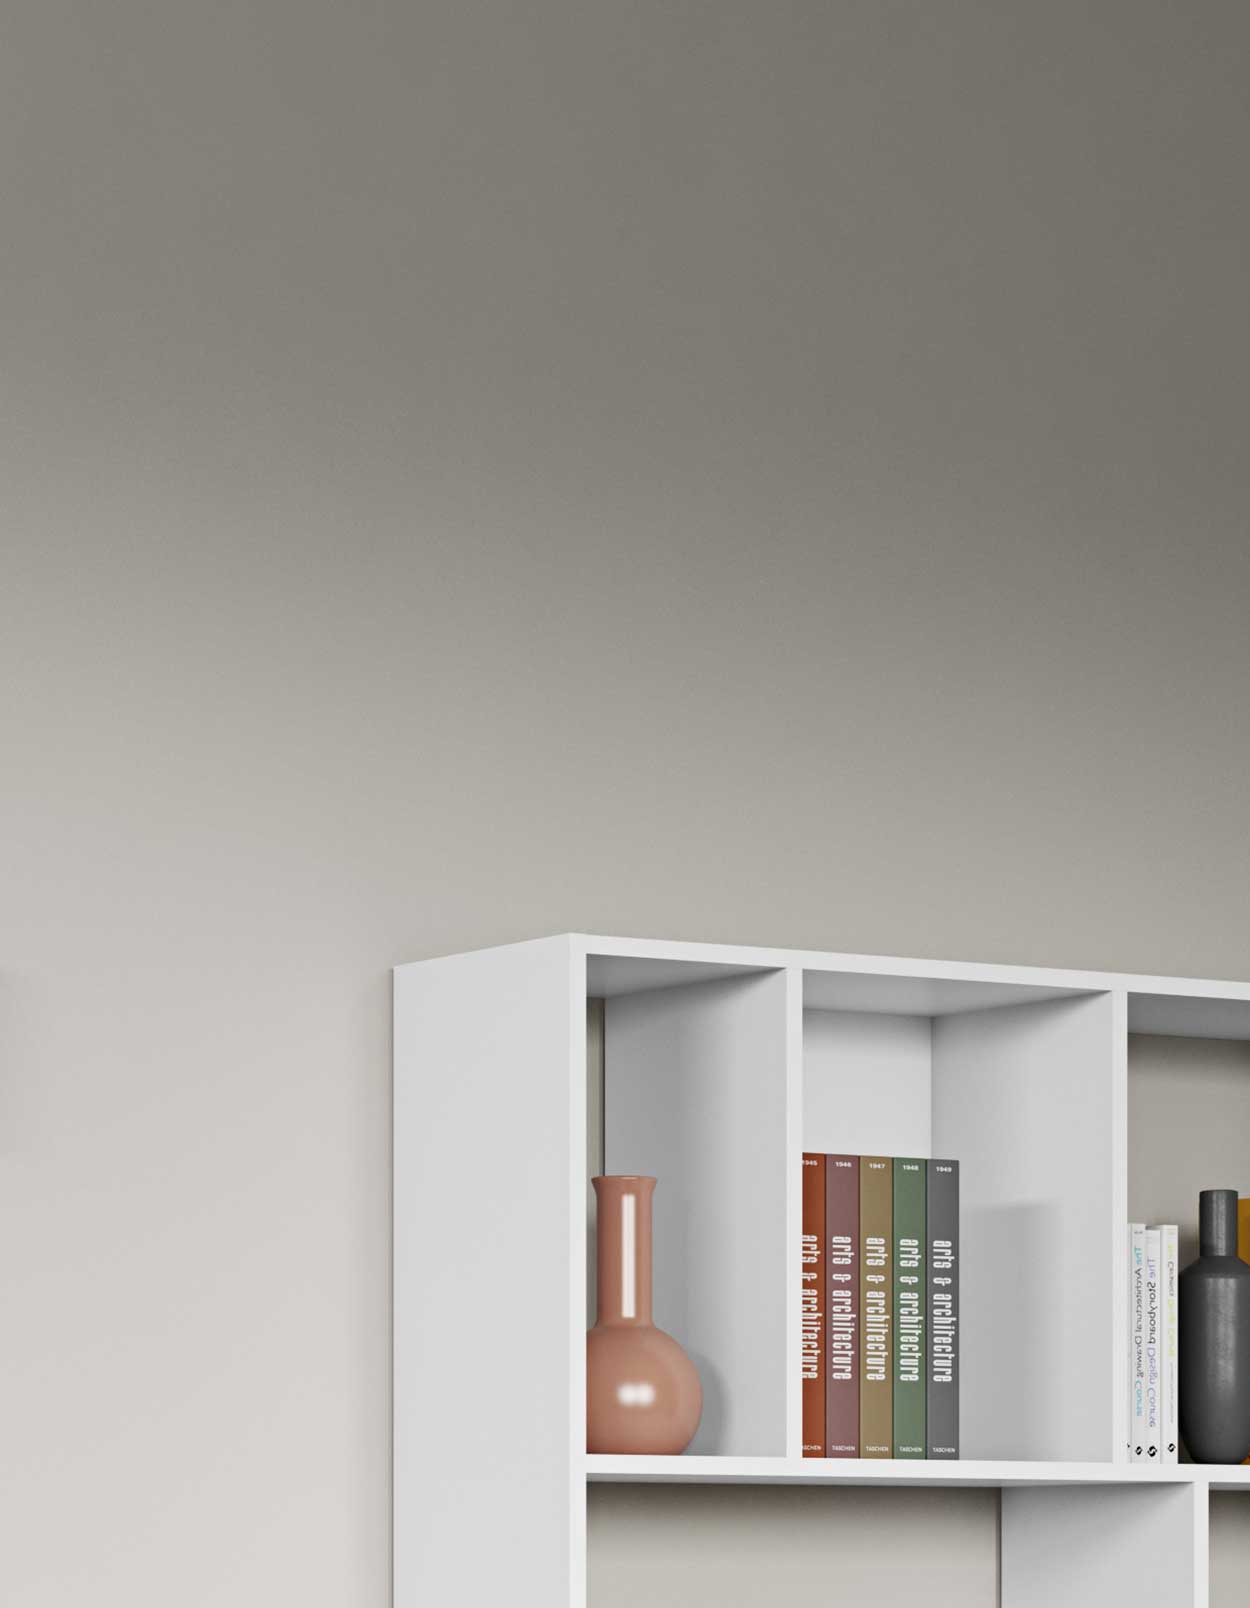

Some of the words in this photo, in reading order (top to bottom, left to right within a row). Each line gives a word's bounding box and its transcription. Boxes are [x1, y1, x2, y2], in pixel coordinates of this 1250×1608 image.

[802, 1235, 821, 1263] arts
[832, 1236, 855, 1265] arts
[866, 1238, 888, 1266] arts
[899, 1239, 922, 1267] arts
[933, 1240, 955, 1269] arts
[802, 1289, 823, 1379] architecture
[832, 1290, 856, 1380] architecture
[866, 1291, 890, 1381] architecture
[899, 1292, 924, 1382] architecture
[933, 1293, 957, 1383] architecture
